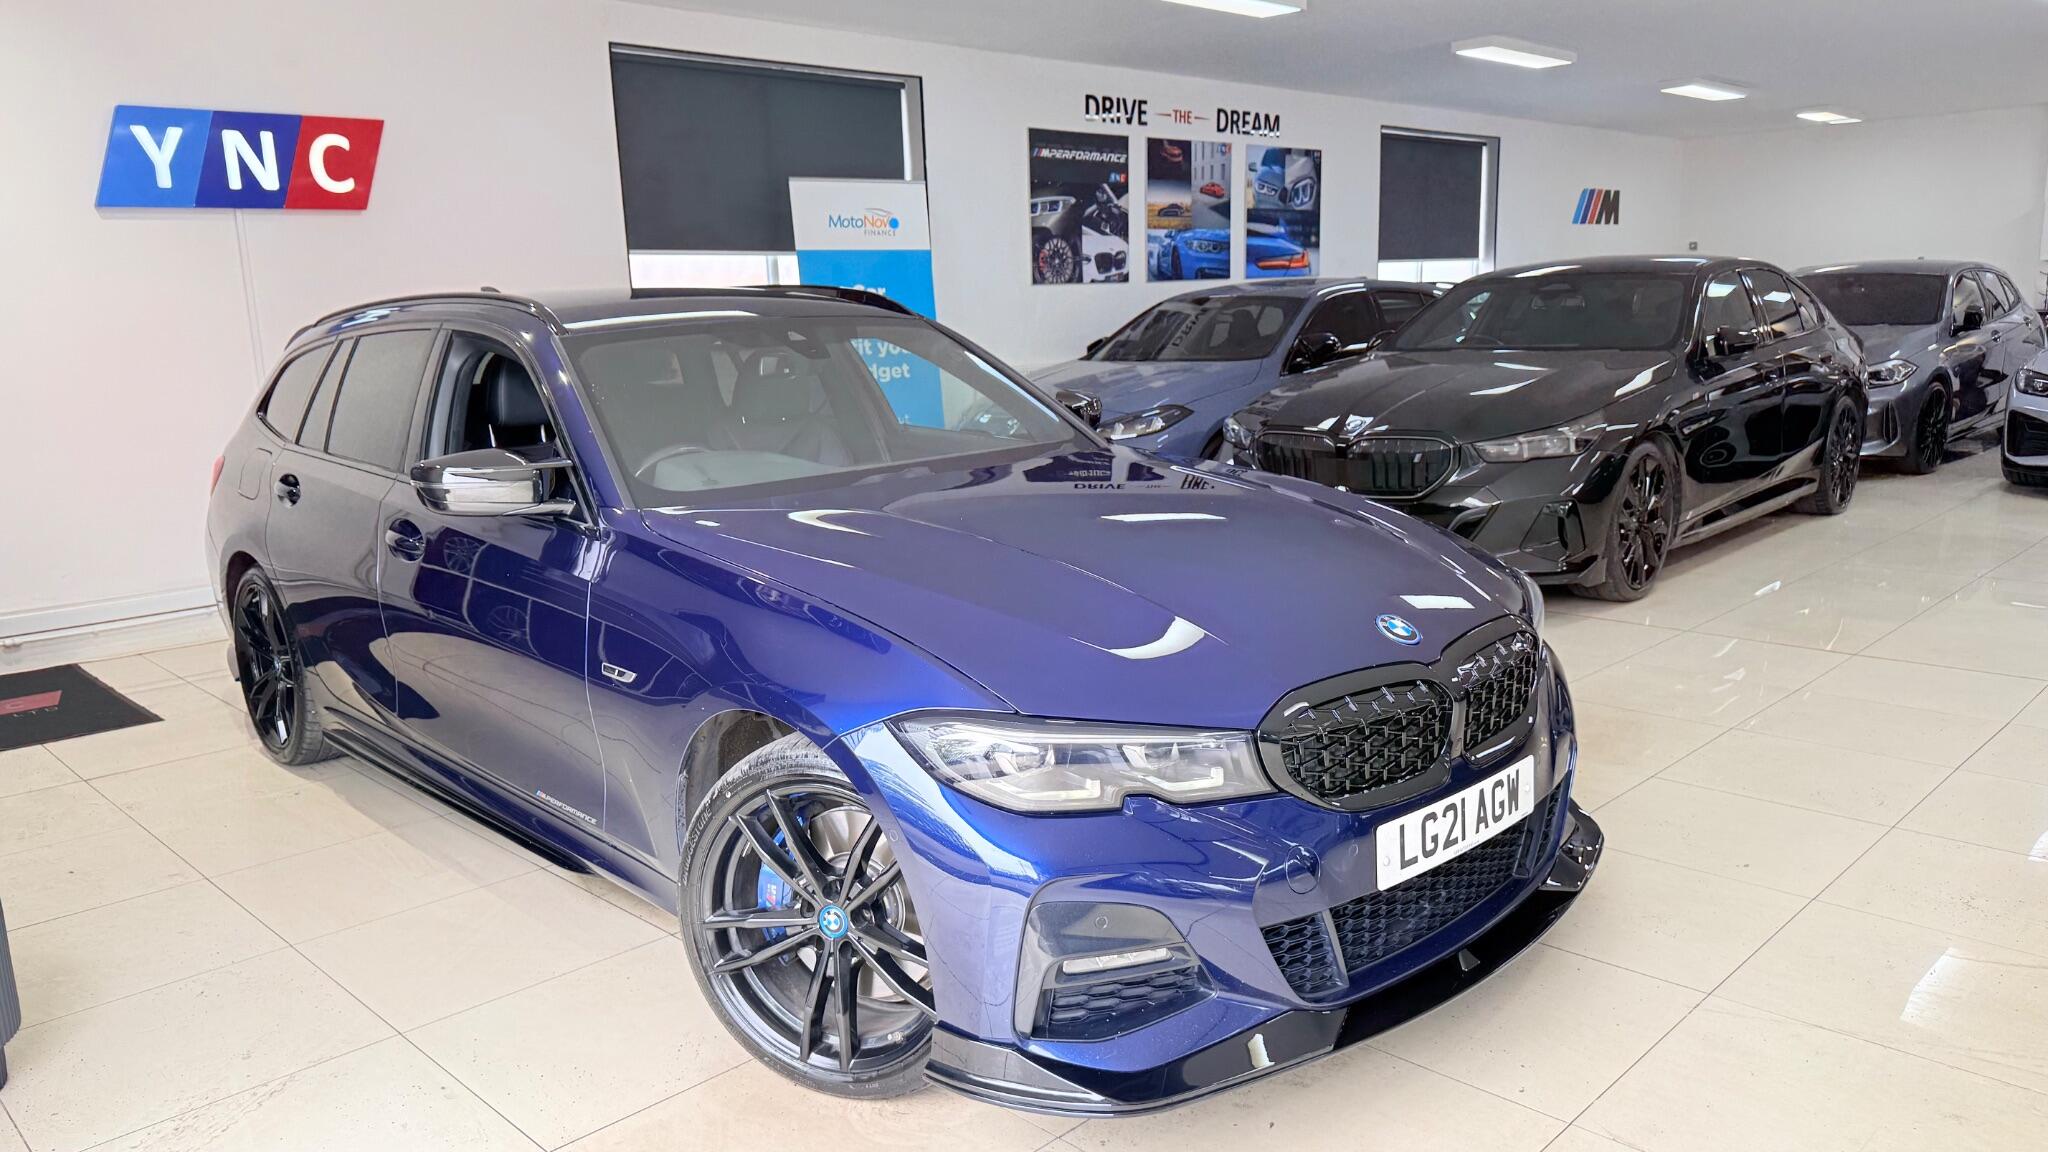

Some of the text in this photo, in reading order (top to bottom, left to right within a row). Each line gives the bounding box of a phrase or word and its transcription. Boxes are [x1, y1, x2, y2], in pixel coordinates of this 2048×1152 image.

[1084, 94, 1281, 138] DRIVE THE DREAM
[129, 124, 356, 194] YNC
[1400, 768, 1520, 871] LG21 AGW
